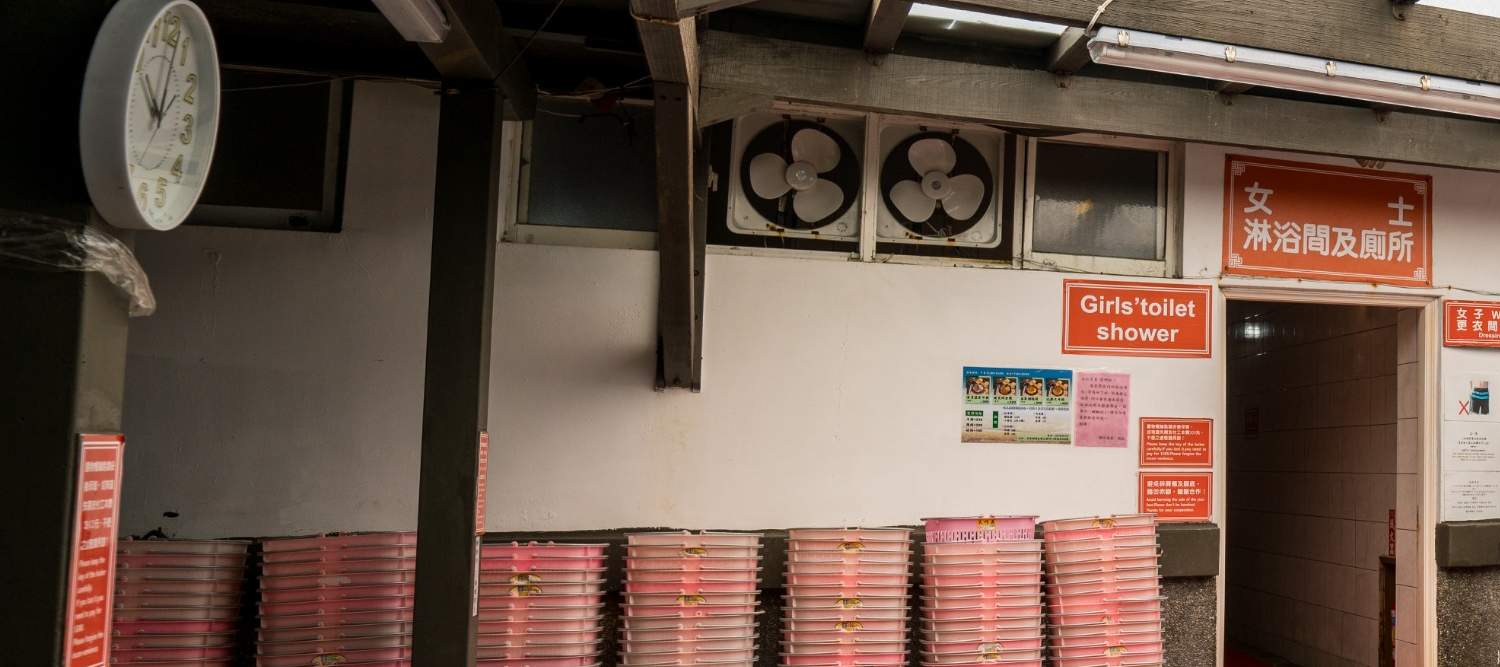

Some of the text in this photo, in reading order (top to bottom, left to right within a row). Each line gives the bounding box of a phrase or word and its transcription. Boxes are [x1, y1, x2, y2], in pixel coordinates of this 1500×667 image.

[161, 11, 181, 49] 12
[181, 36, 192, 67] 1
[183, 73, 197, 105] 2
[180, 113, 193, 145] 3
[171, 154, 183, 184] 4
[155, 176, 168, 208] 5
[1243, 218, 1415, 263] 淋浴間及廁所
[1097, 322, 1179, 342] shower
